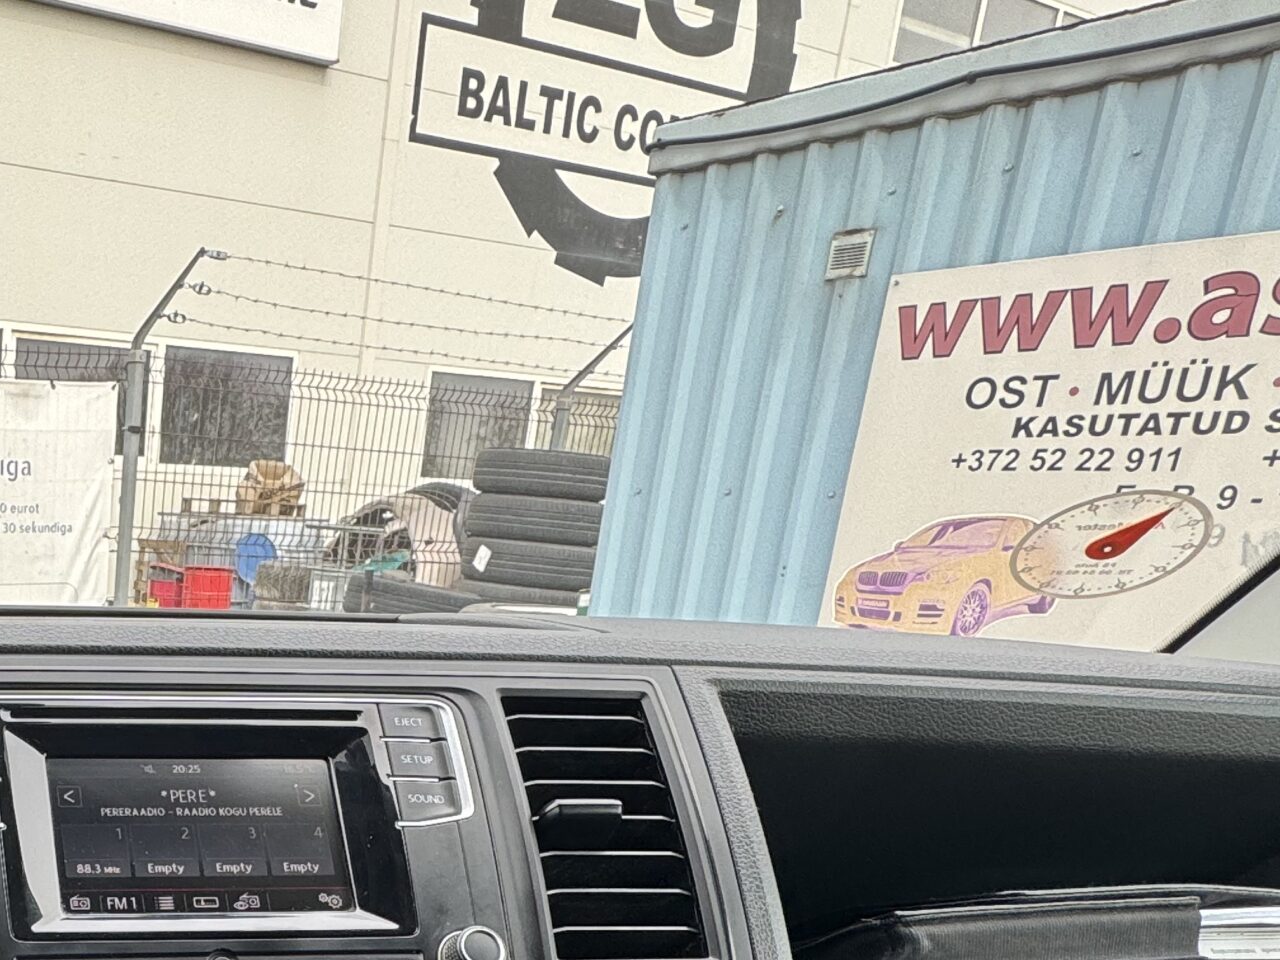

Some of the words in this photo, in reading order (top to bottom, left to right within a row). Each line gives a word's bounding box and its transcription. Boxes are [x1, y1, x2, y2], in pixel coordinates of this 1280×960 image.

[458, 67, 602, 143] BALTIC
[614, 104, 681, 154] CO
[965, 374, 1060, 410] OST
[1093, 358, 1259, 406] MÜÜK
[1011, 410, 1250, 438] KASUTATUD
[951, 449, 1021, 472] +372
[1029, 448, 1067, 472] 52
[1074, 448, 1115, 472] 22
[1124, 447, 1182, 472] 911
[10, 503, 40, 514] eurot
[3, 522, 16, 534] 30
[19, 521, 73, 536] sekundiga
[394, 717, 422, 726] EJECT
[400, 755, 433, 764] SETUP
[172, 764, 201, 774] 20:25
[407, 794, 445, 804] SOUND
[100, 807, 166, 817] PERERAADIO
[176, 807, 217, 817] RAADIO
[219, 807, 247, 817] KOGU
[249, 806, 283, 816] PERELE
[115, 828, 122, 840] 1
[181, 827, 190, 839] 2
[248, 827, 257, 839] 3
[314, 826, 323, 838] 4
[76, 864, 101, 874] 88.3
[147, 863, 185, 875] Empty
[215, 862, 253, 874] Empty
[283, 862, 320, 873] Empty
